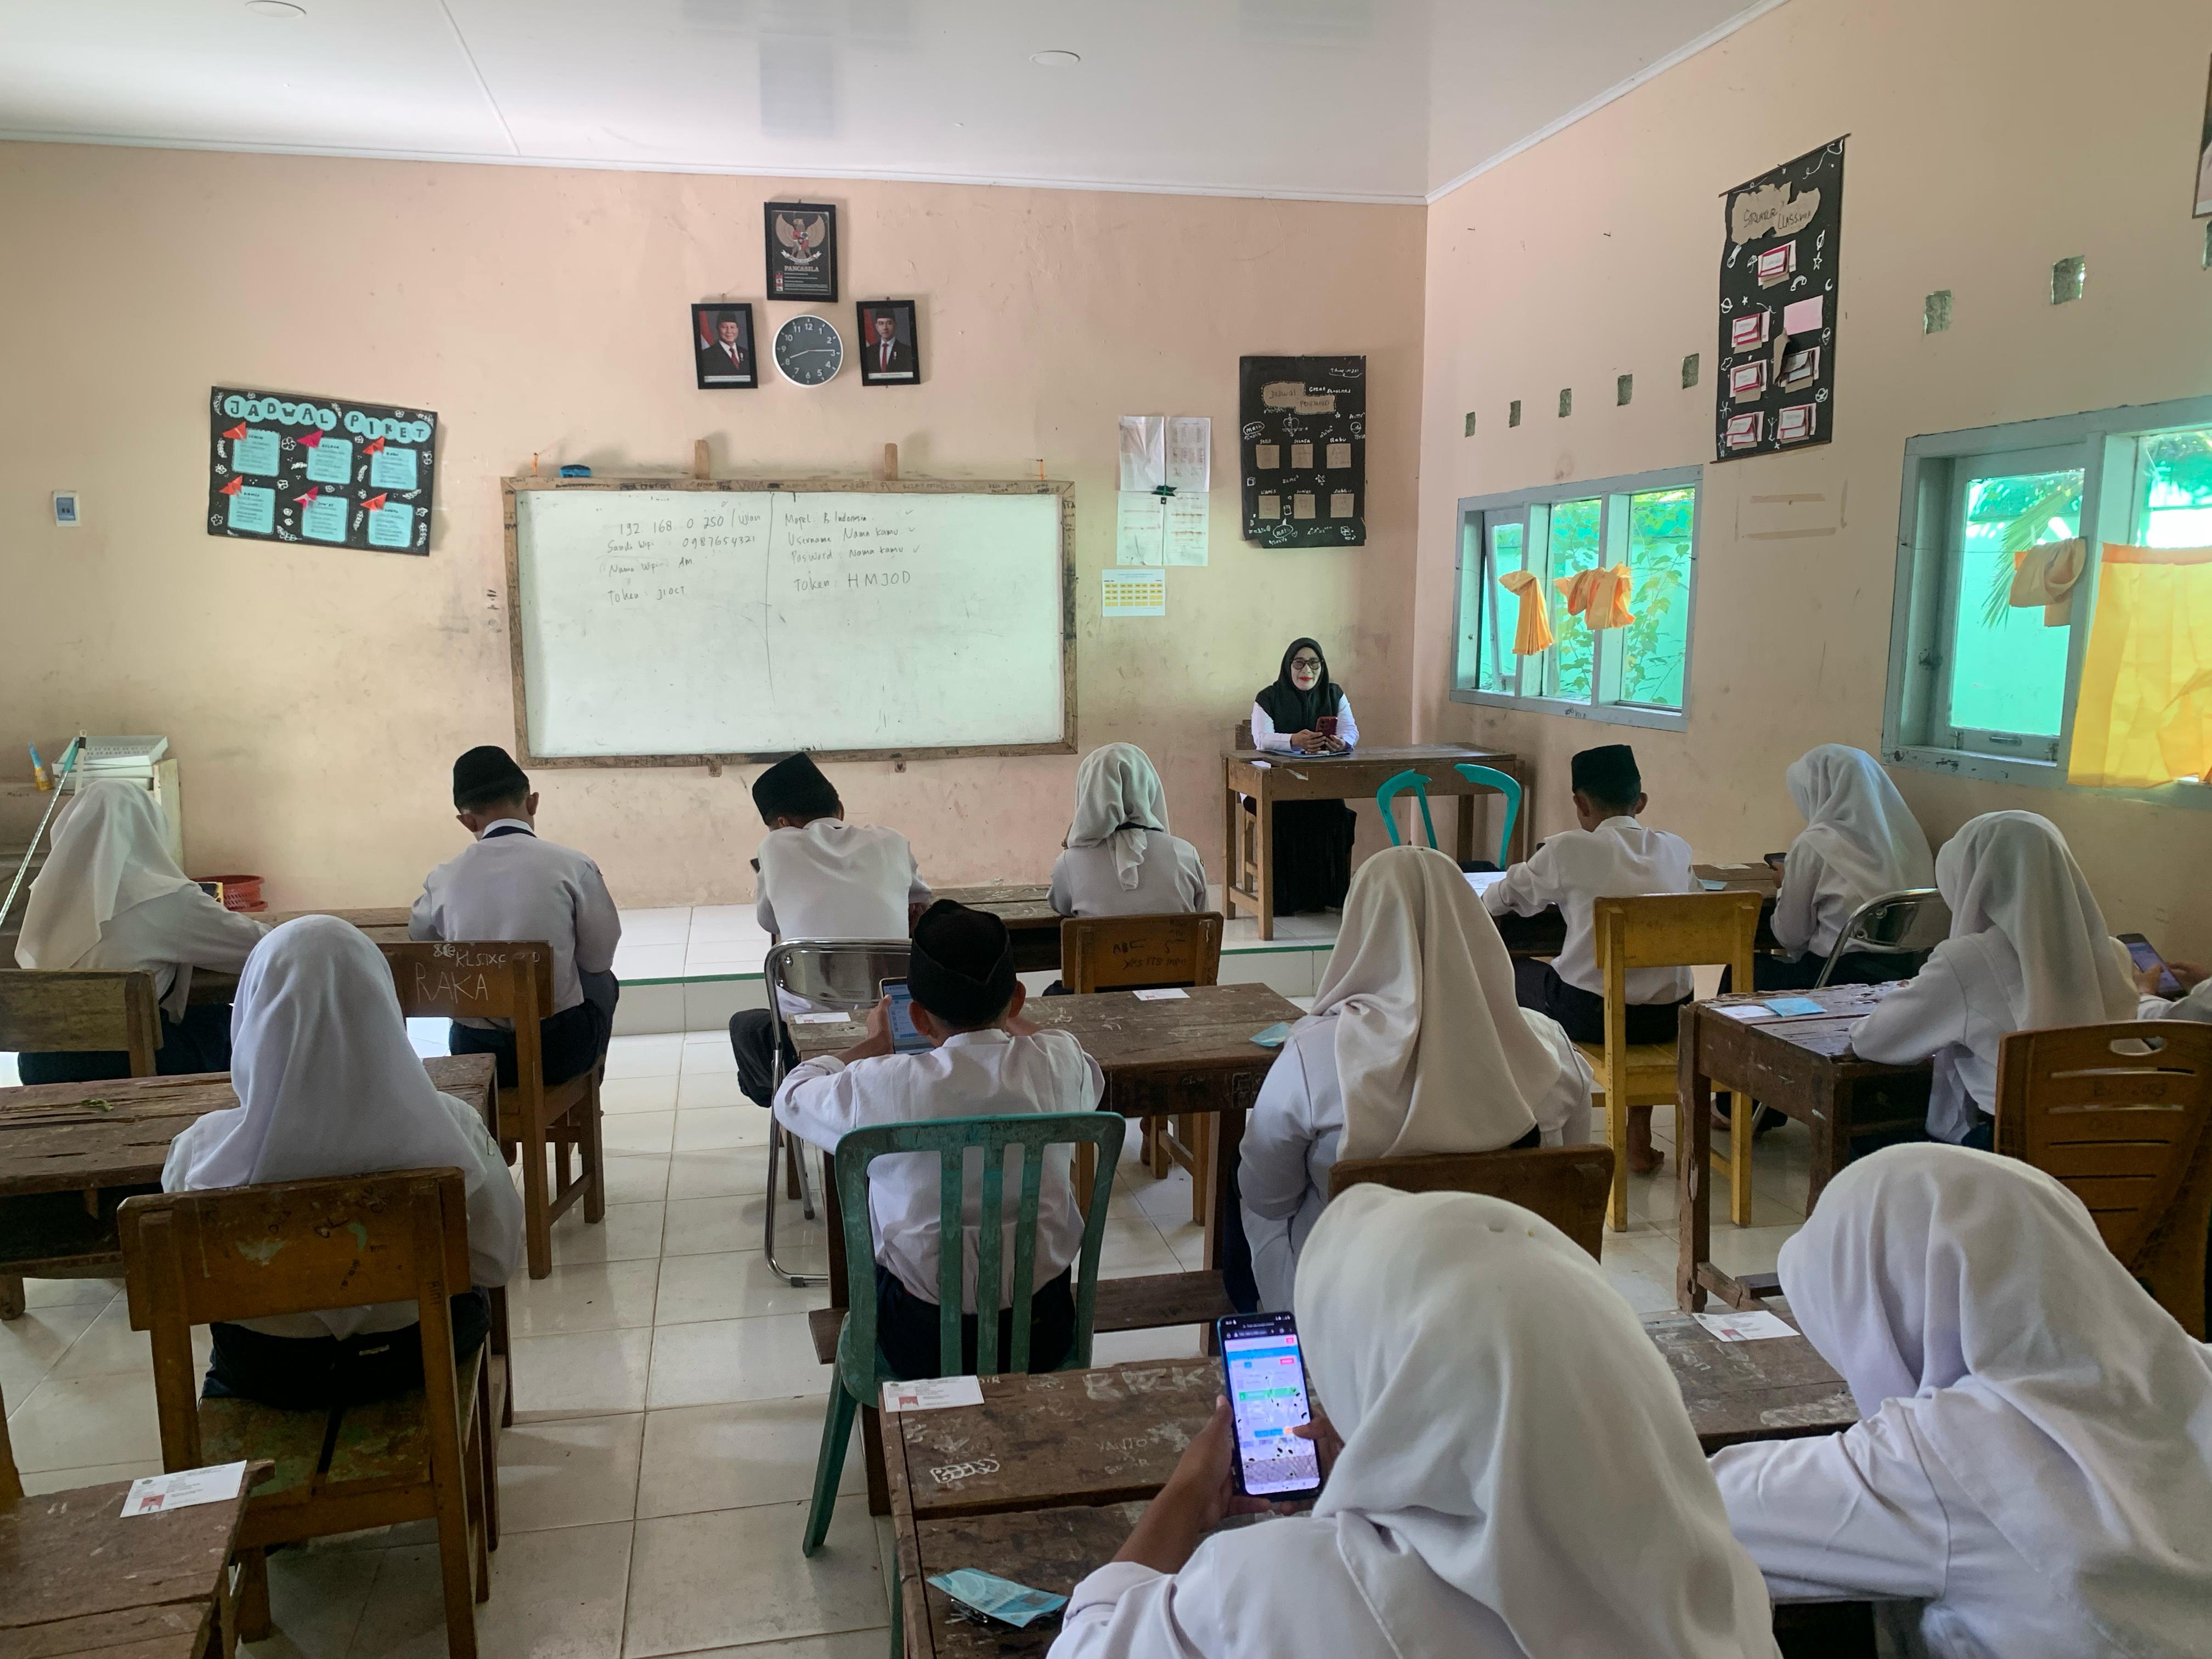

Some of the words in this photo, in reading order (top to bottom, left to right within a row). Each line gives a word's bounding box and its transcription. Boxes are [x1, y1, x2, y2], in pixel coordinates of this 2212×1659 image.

[230, 400, 329, 424] JADWAL
[350, 415, 425, 438] PIKET
[620, 522, 641, 536] 192
[653, 519, 673, 534] 168
[703, 515, 725, 529] 250
[682, 535, 755, 549] 0987654321
[415, 962, 489, 1004] RAKA
